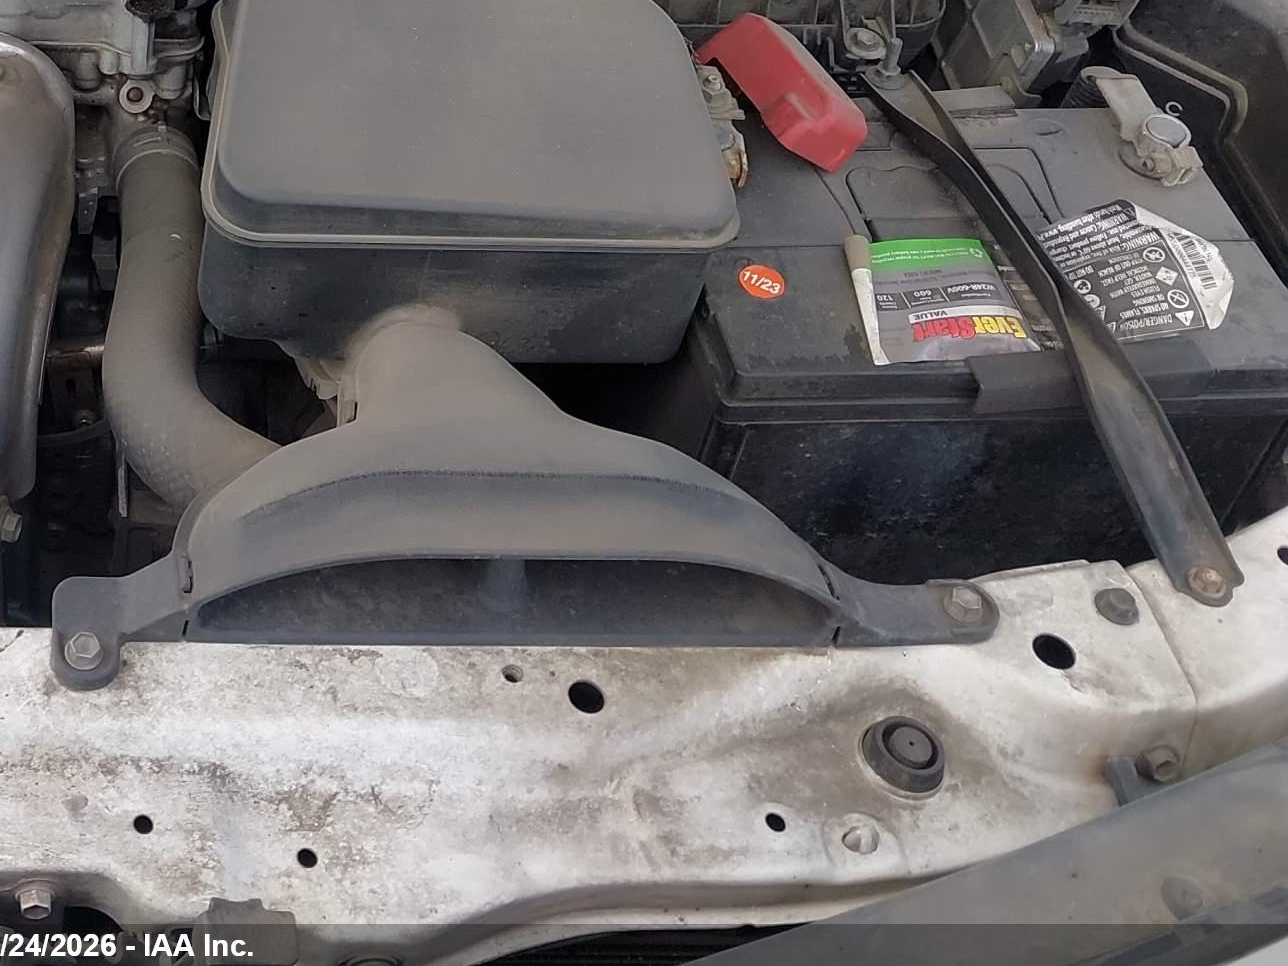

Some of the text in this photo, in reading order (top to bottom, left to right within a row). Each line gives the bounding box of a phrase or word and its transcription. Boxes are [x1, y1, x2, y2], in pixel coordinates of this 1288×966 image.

[1120, 231, 1160, 251] WARNING:
[743, 271, 781, 294] 11/23
[913, 310, 948, 321] VALUE
[912, 315, 1028, 342] EverStart
